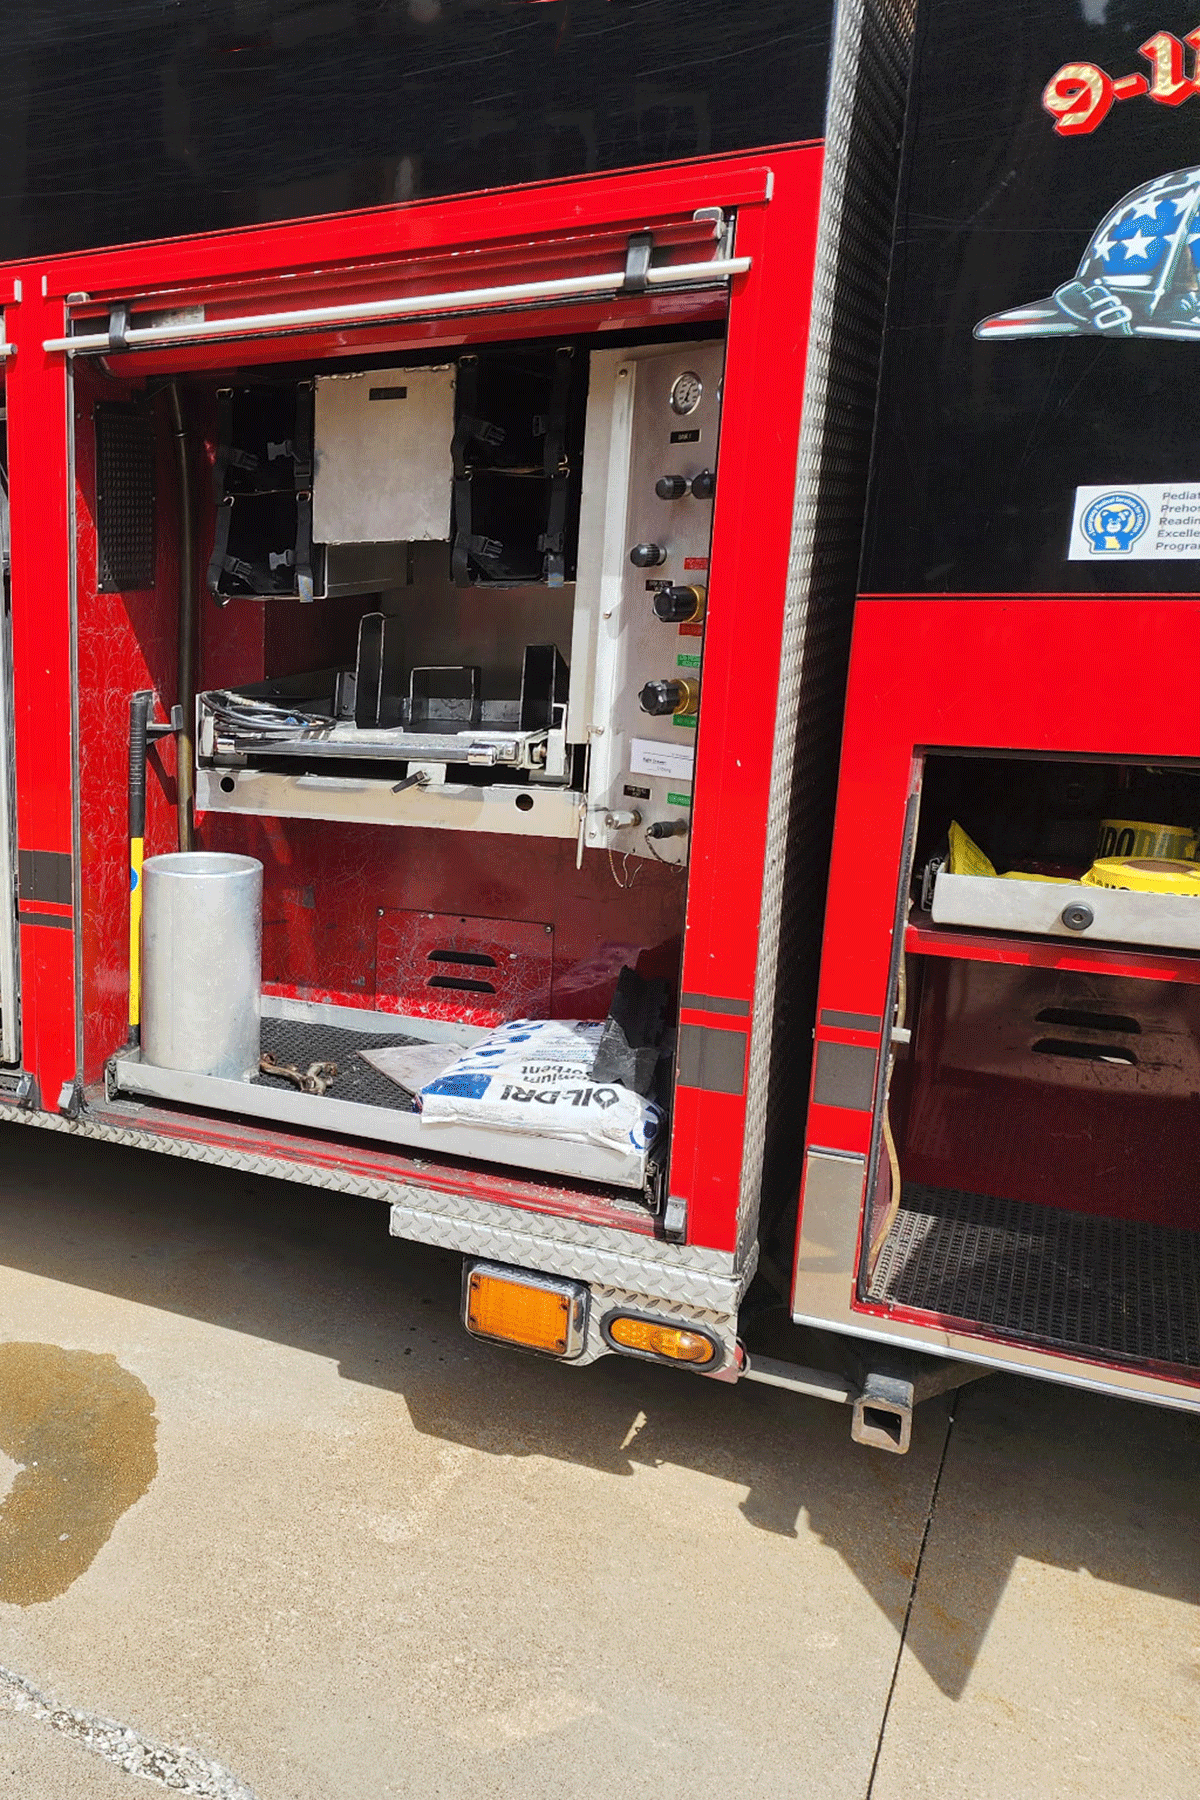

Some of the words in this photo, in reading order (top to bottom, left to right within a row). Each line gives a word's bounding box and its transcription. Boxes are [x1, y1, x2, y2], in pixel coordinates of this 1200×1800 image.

[1155, 541, 1200, 553] Progra
[523, 1073, 590, 1085] emium
[500, 1084, 620, 1111] OIL-DRI
